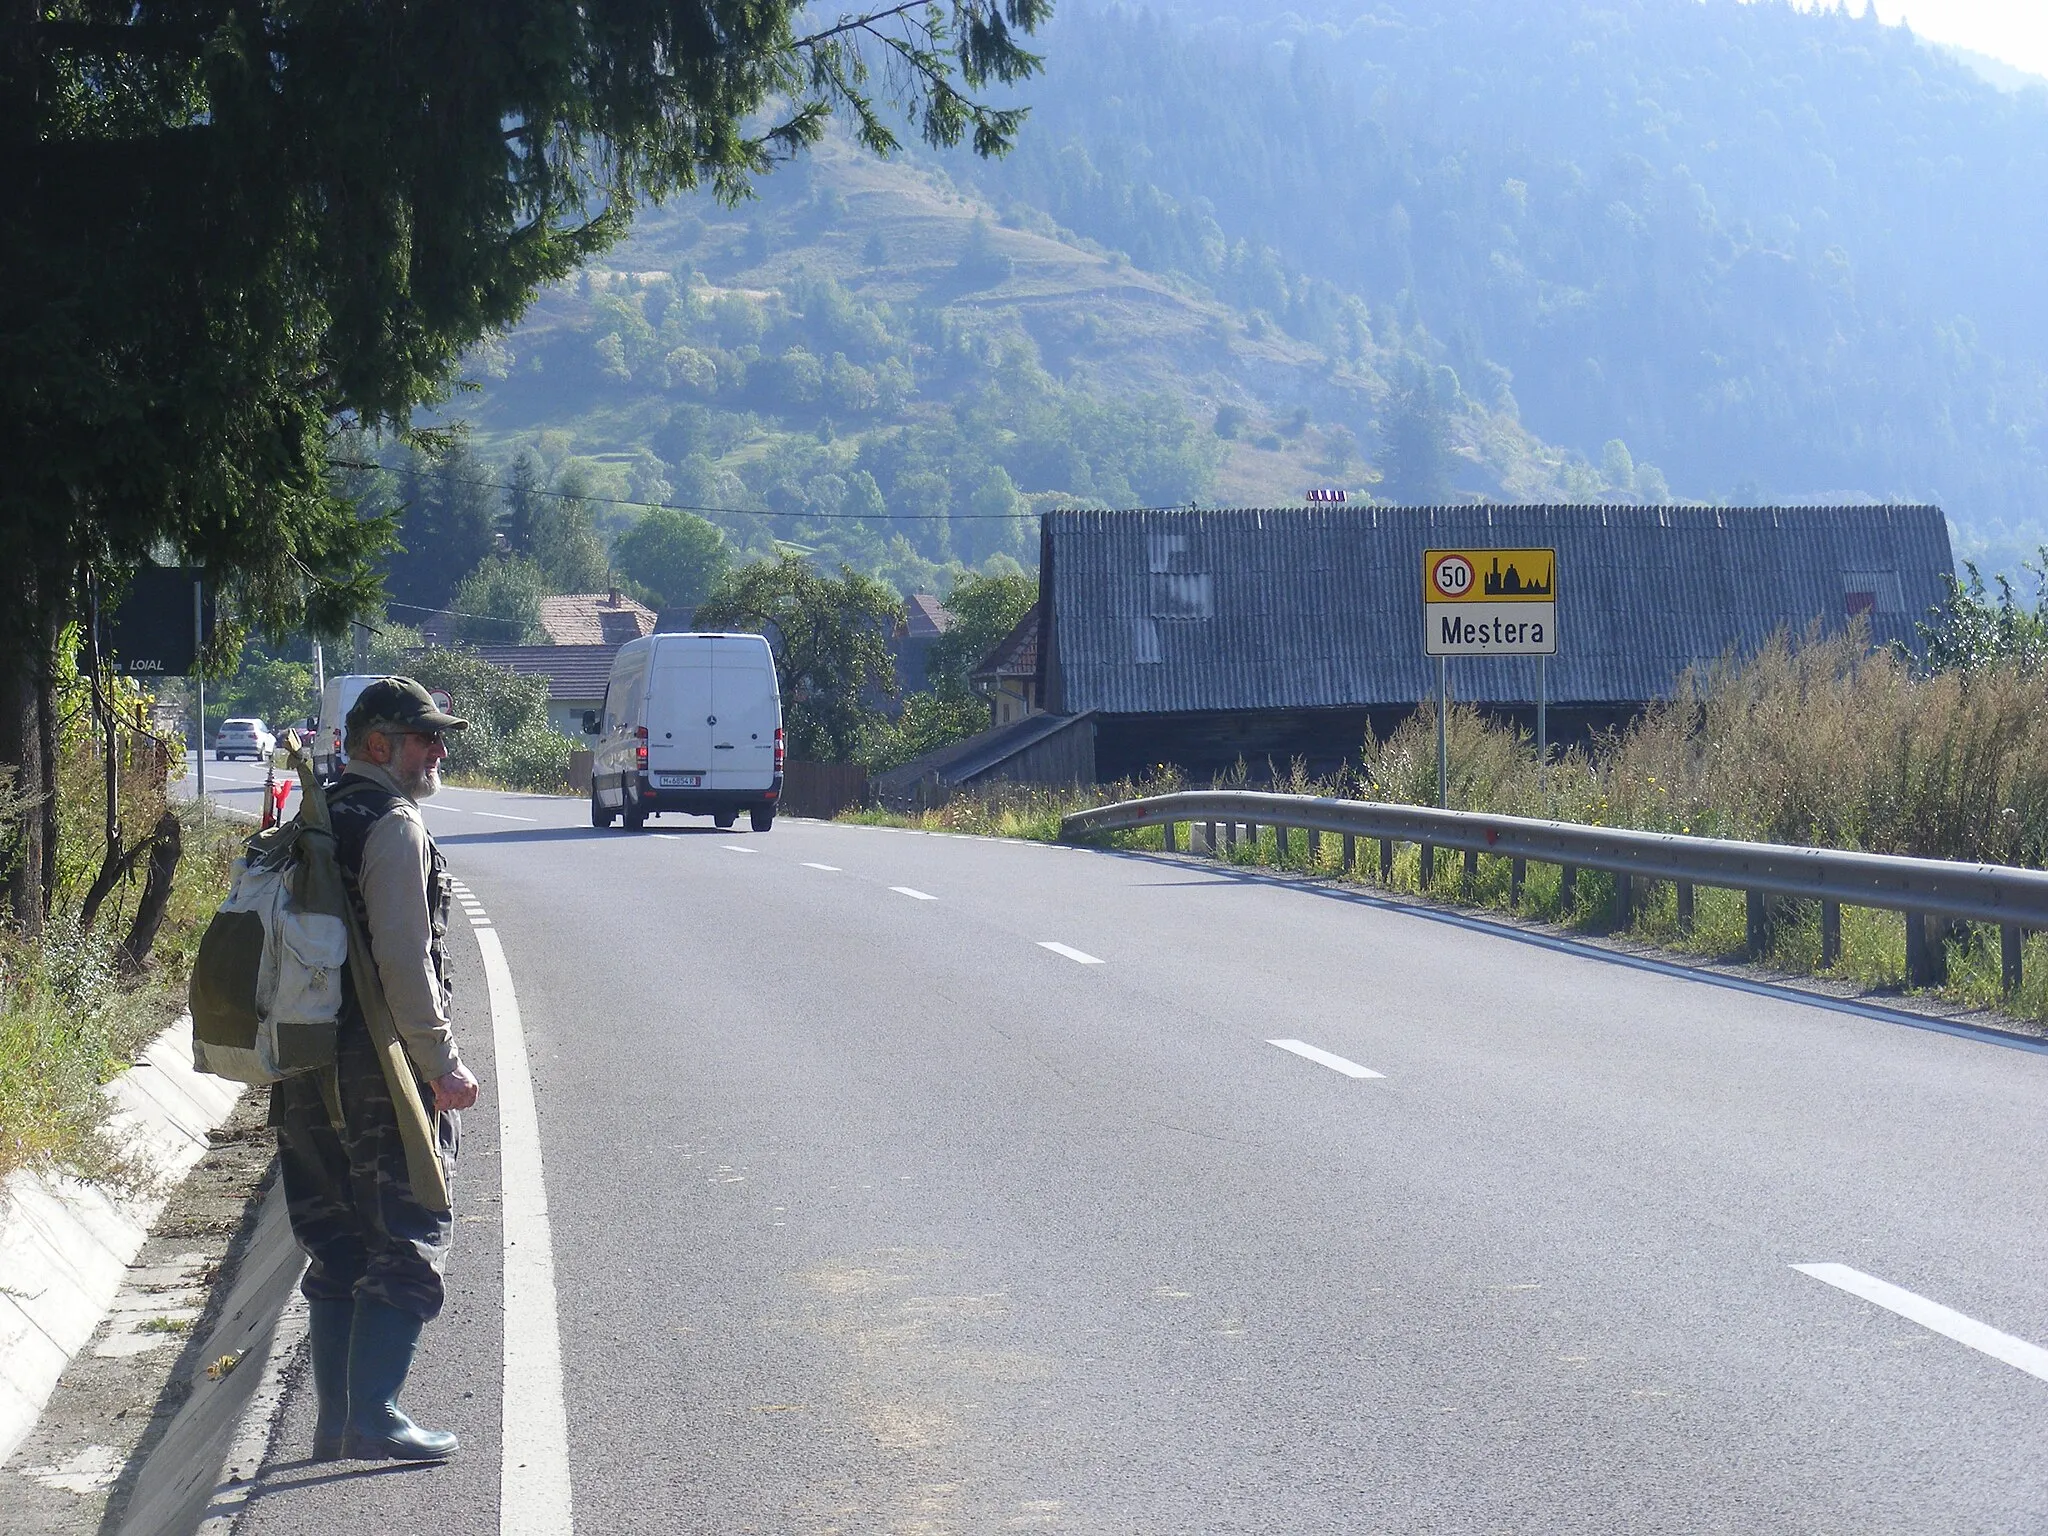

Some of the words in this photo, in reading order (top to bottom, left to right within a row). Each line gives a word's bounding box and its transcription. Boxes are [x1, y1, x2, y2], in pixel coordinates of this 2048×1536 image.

[1442, 566, 1466, 588] 50
[1441, 616, 1544, 648] Meștera
[129, 659, 164, 671] LOIAL
